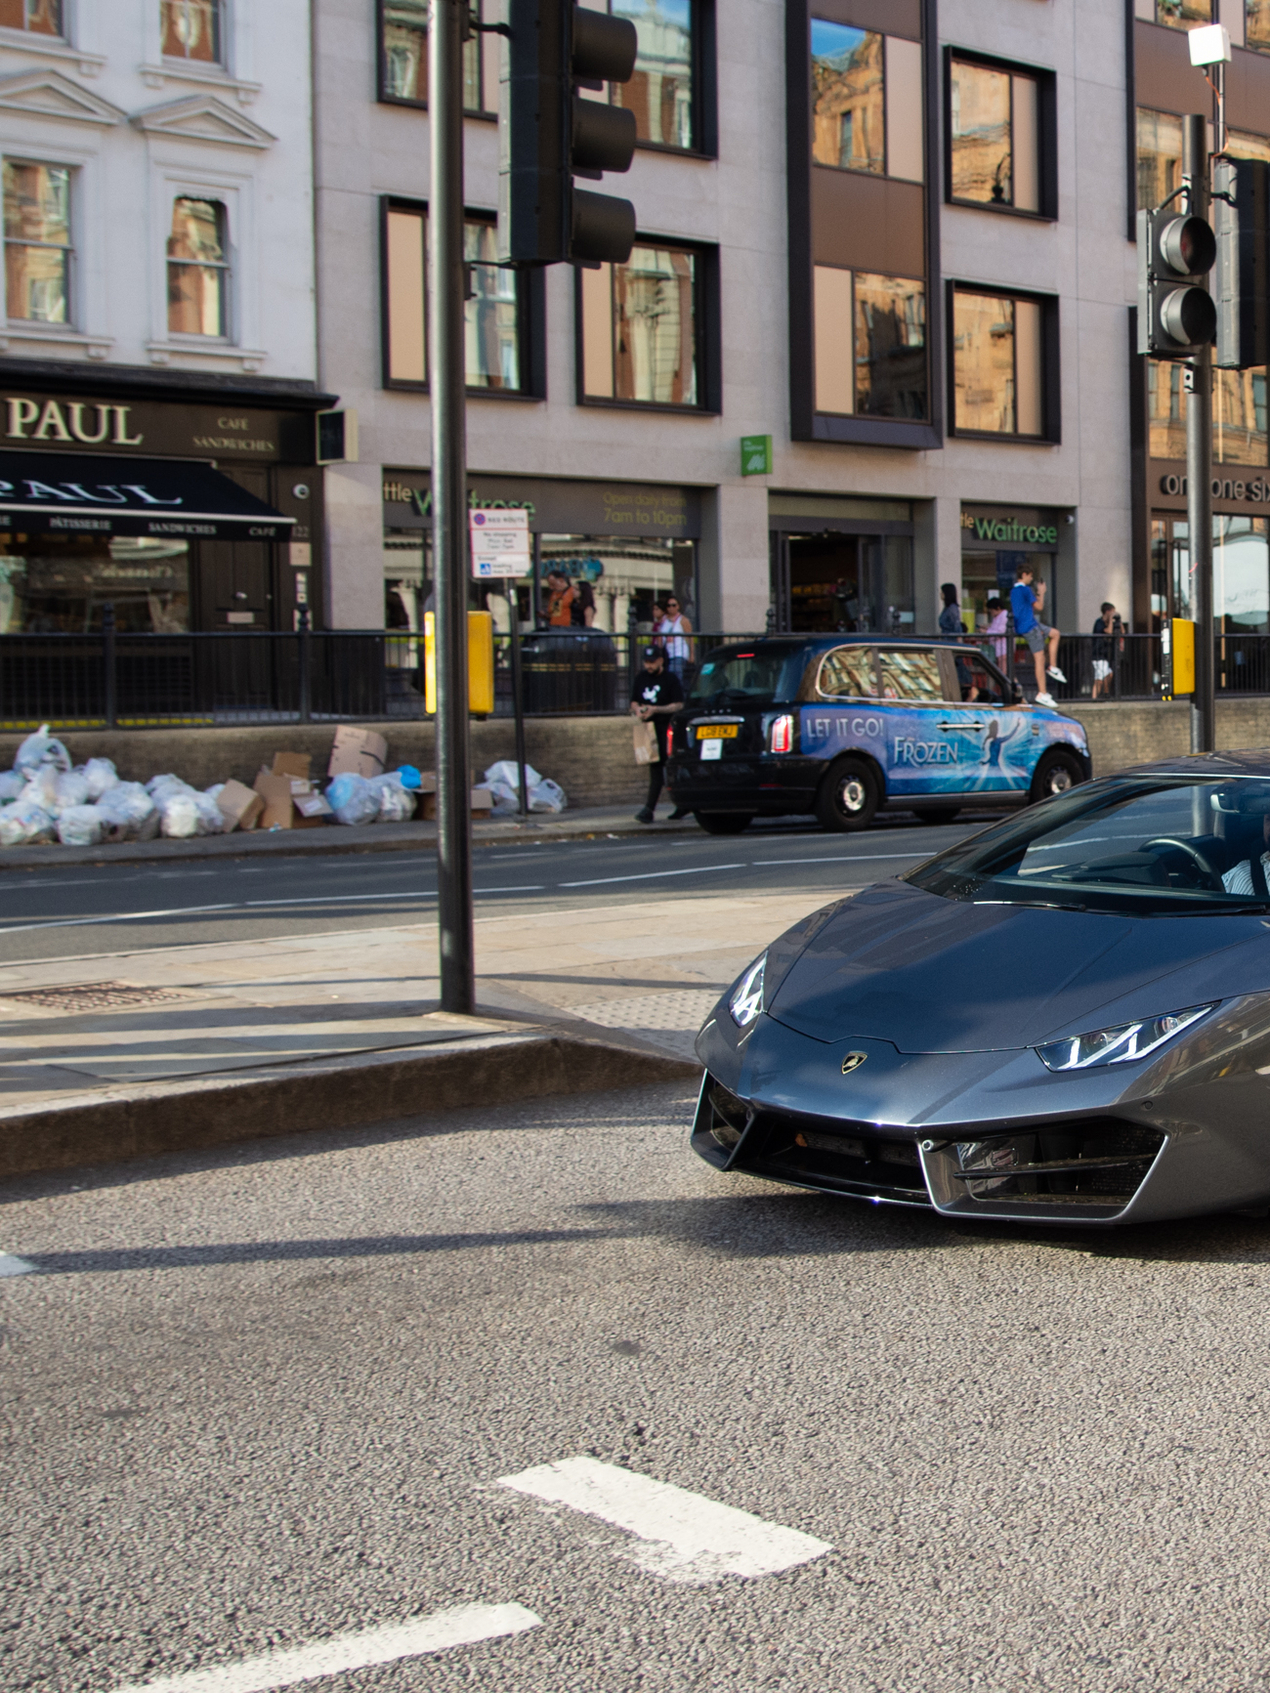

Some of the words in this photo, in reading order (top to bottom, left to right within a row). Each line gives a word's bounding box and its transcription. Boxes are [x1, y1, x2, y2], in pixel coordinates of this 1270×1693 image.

[5, 397, 144, 446] PAUL
[192, 436, 274, 451] SANDWICHES
[1166, 474, 1188, 496] on
[1211, 478, 1246, 500] one
[149, 521, 218, 536] SANDWICHES
[603, 507, 633, 524] 7am
[636, 509, 650, 525] to
[653, 510, 687, 529] 10pm
[975, 517, 1058, 544] Waitrose
[806, 719, 831, 738] LET
[836, 718, 848, 737] IT
[851, 717, 884, 737] GO!
[894, 736, 959, 768] FROZEN
